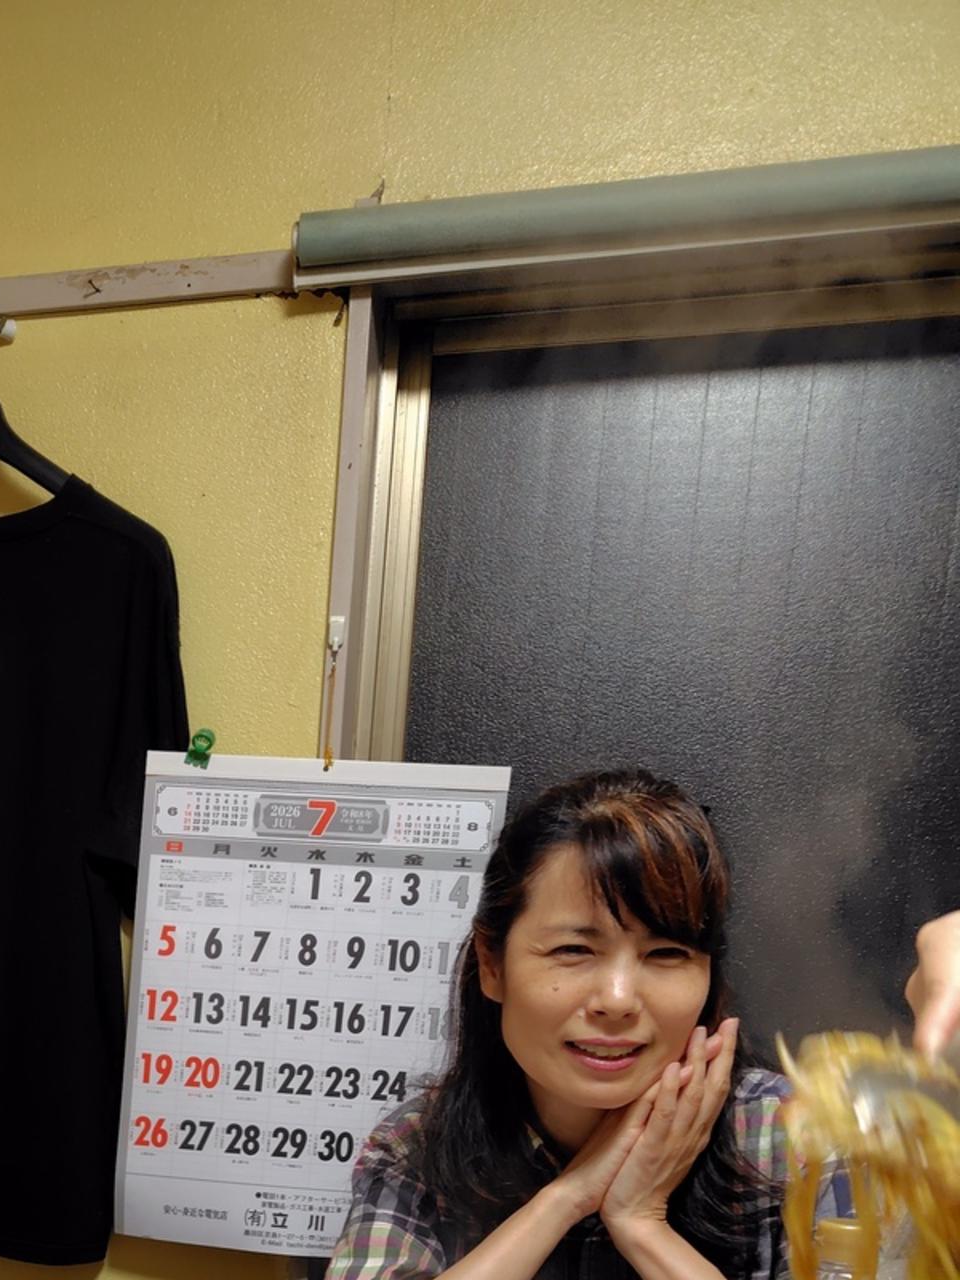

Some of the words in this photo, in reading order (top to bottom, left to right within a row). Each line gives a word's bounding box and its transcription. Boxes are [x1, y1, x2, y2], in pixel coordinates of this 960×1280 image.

[167, 806, 178, 817] 6
[269, 804, 301, 817] 2026
[271, 818, 296, 829] JUL
[307, 799, 337, 837] 7
[466, 821, 479, 832] 8
[165, 841, 183, 852] 日
[213, 843, 231, 855] 月
[260, 846, 279, 858] 火
[307, 849, 326, 861] 水
[355, 852, 375, 863] 木
[404, 854, 424, 866] 金
[453, 857, 472, 868] 土
[310, 868, 321, 899] 1
[353, 871, 373, 903] 2
[400, 873, 421, 906] 3
[449, 875, 470, 909] 4
[157, 925, 177, 957] 5
[204, 928, 223, 959] 6
[250, 931, 271, 962] 7
[298, 933, 317, 966] 8
[346, 936, 366, 969] 9
[388, 939, 421, 972] 10
[147, 989, 179, 1022] 12
[192, 992, 225, 1025] 13
[239, 995, 271, 1028] 14
[286, 998, 319, 1031] 15
[334, 1001, 366, 1034] 16
[380, 1004, 415, 1037] 17
[141, 1052, 173, 1085] 19
[184, 1056, 220, 1089] 20
[233, 1060, 265, 1092] 21
[277, 1062, 314, 1096] 22
[324, 1066, 361, 1100] 23
[370, 1069, 407, 1102] 24
[133, 1115, 169, 1148] 26
[178, 1119, 215, 1151] 27
[224, 1123, 261, 1156] 28
[271, 1126, 307, 1158] 29
[317, 1129, 354, 1162] 30
